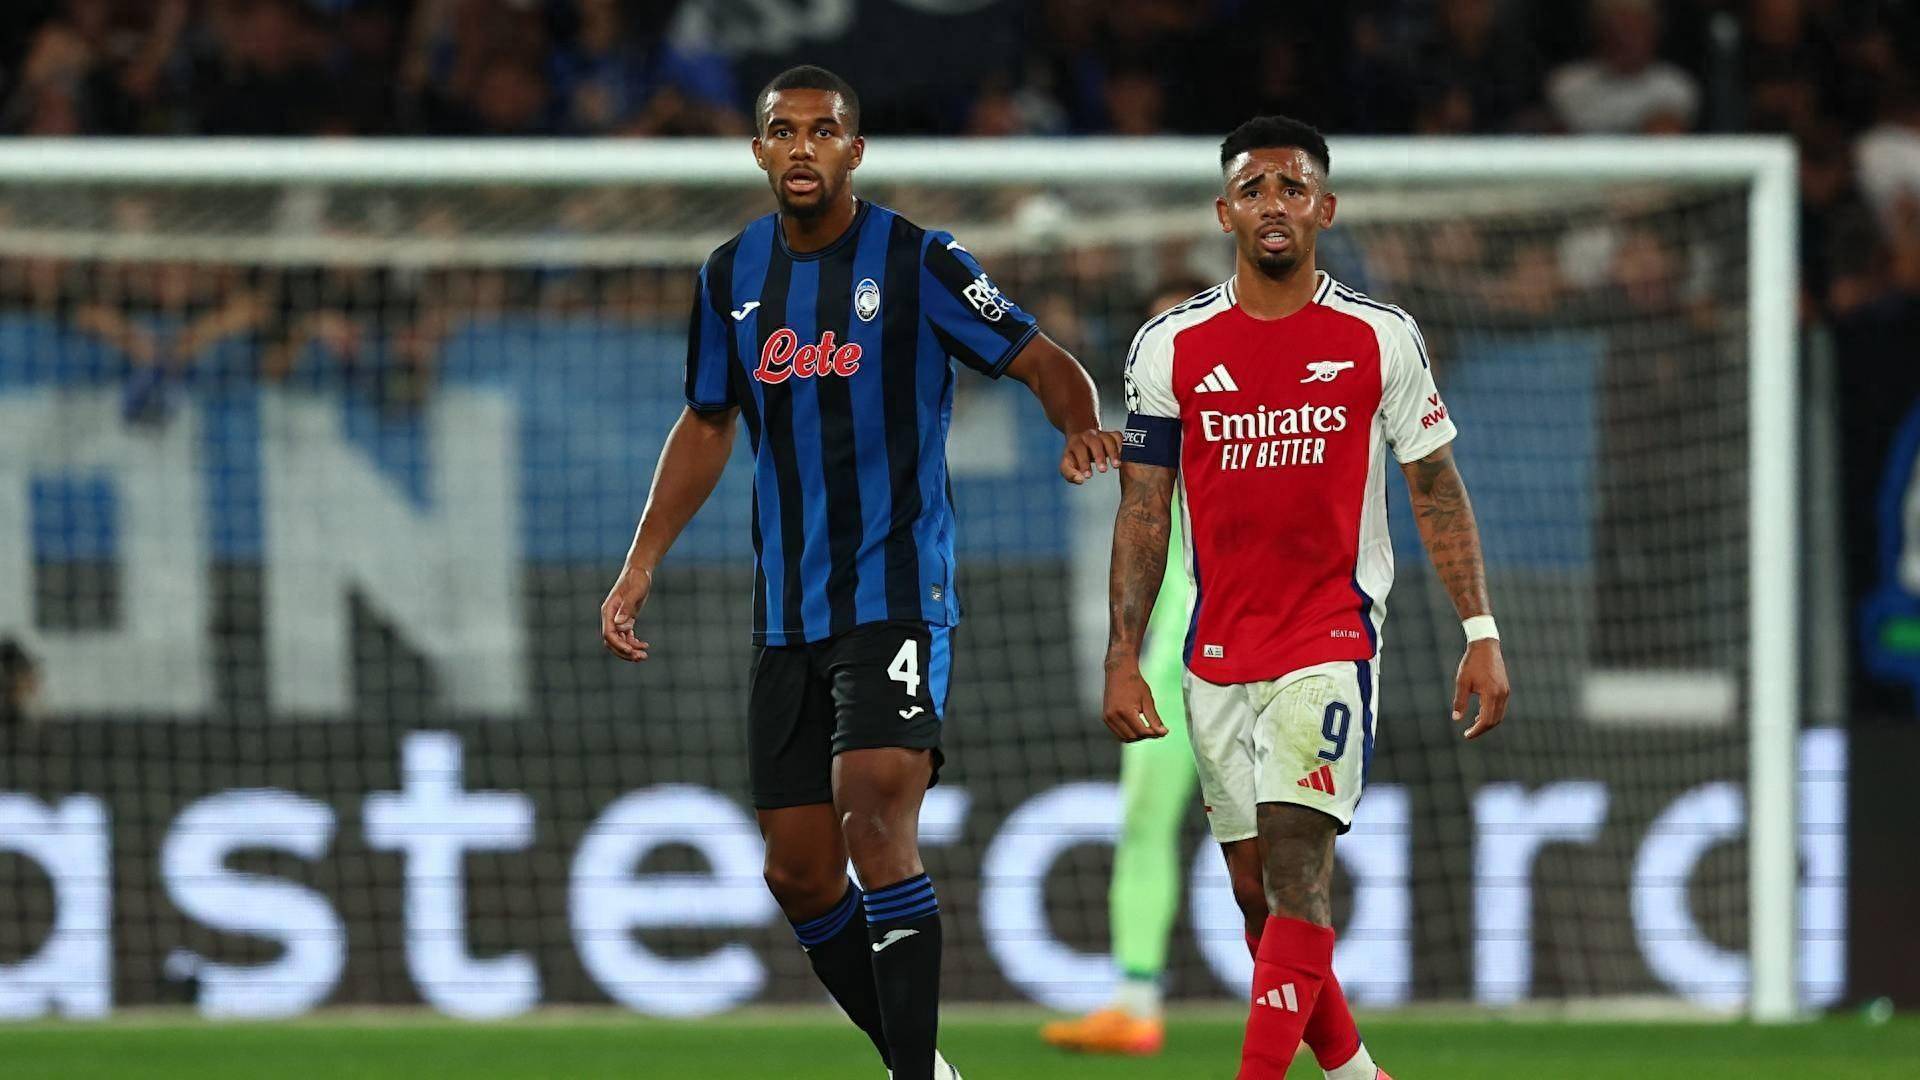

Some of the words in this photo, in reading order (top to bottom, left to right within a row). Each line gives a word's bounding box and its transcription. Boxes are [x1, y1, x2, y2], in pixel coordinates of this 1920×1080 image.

[753, 328, 862, 384] Lete
[1200, 402, 1347, 442] Emirates
[1221, 443, 1253, 470] FLY
[1256, 438, 1326, 468] BETTER
[887, 639, 920, 697] 4
[1317, 701, 1351, 761] 9
